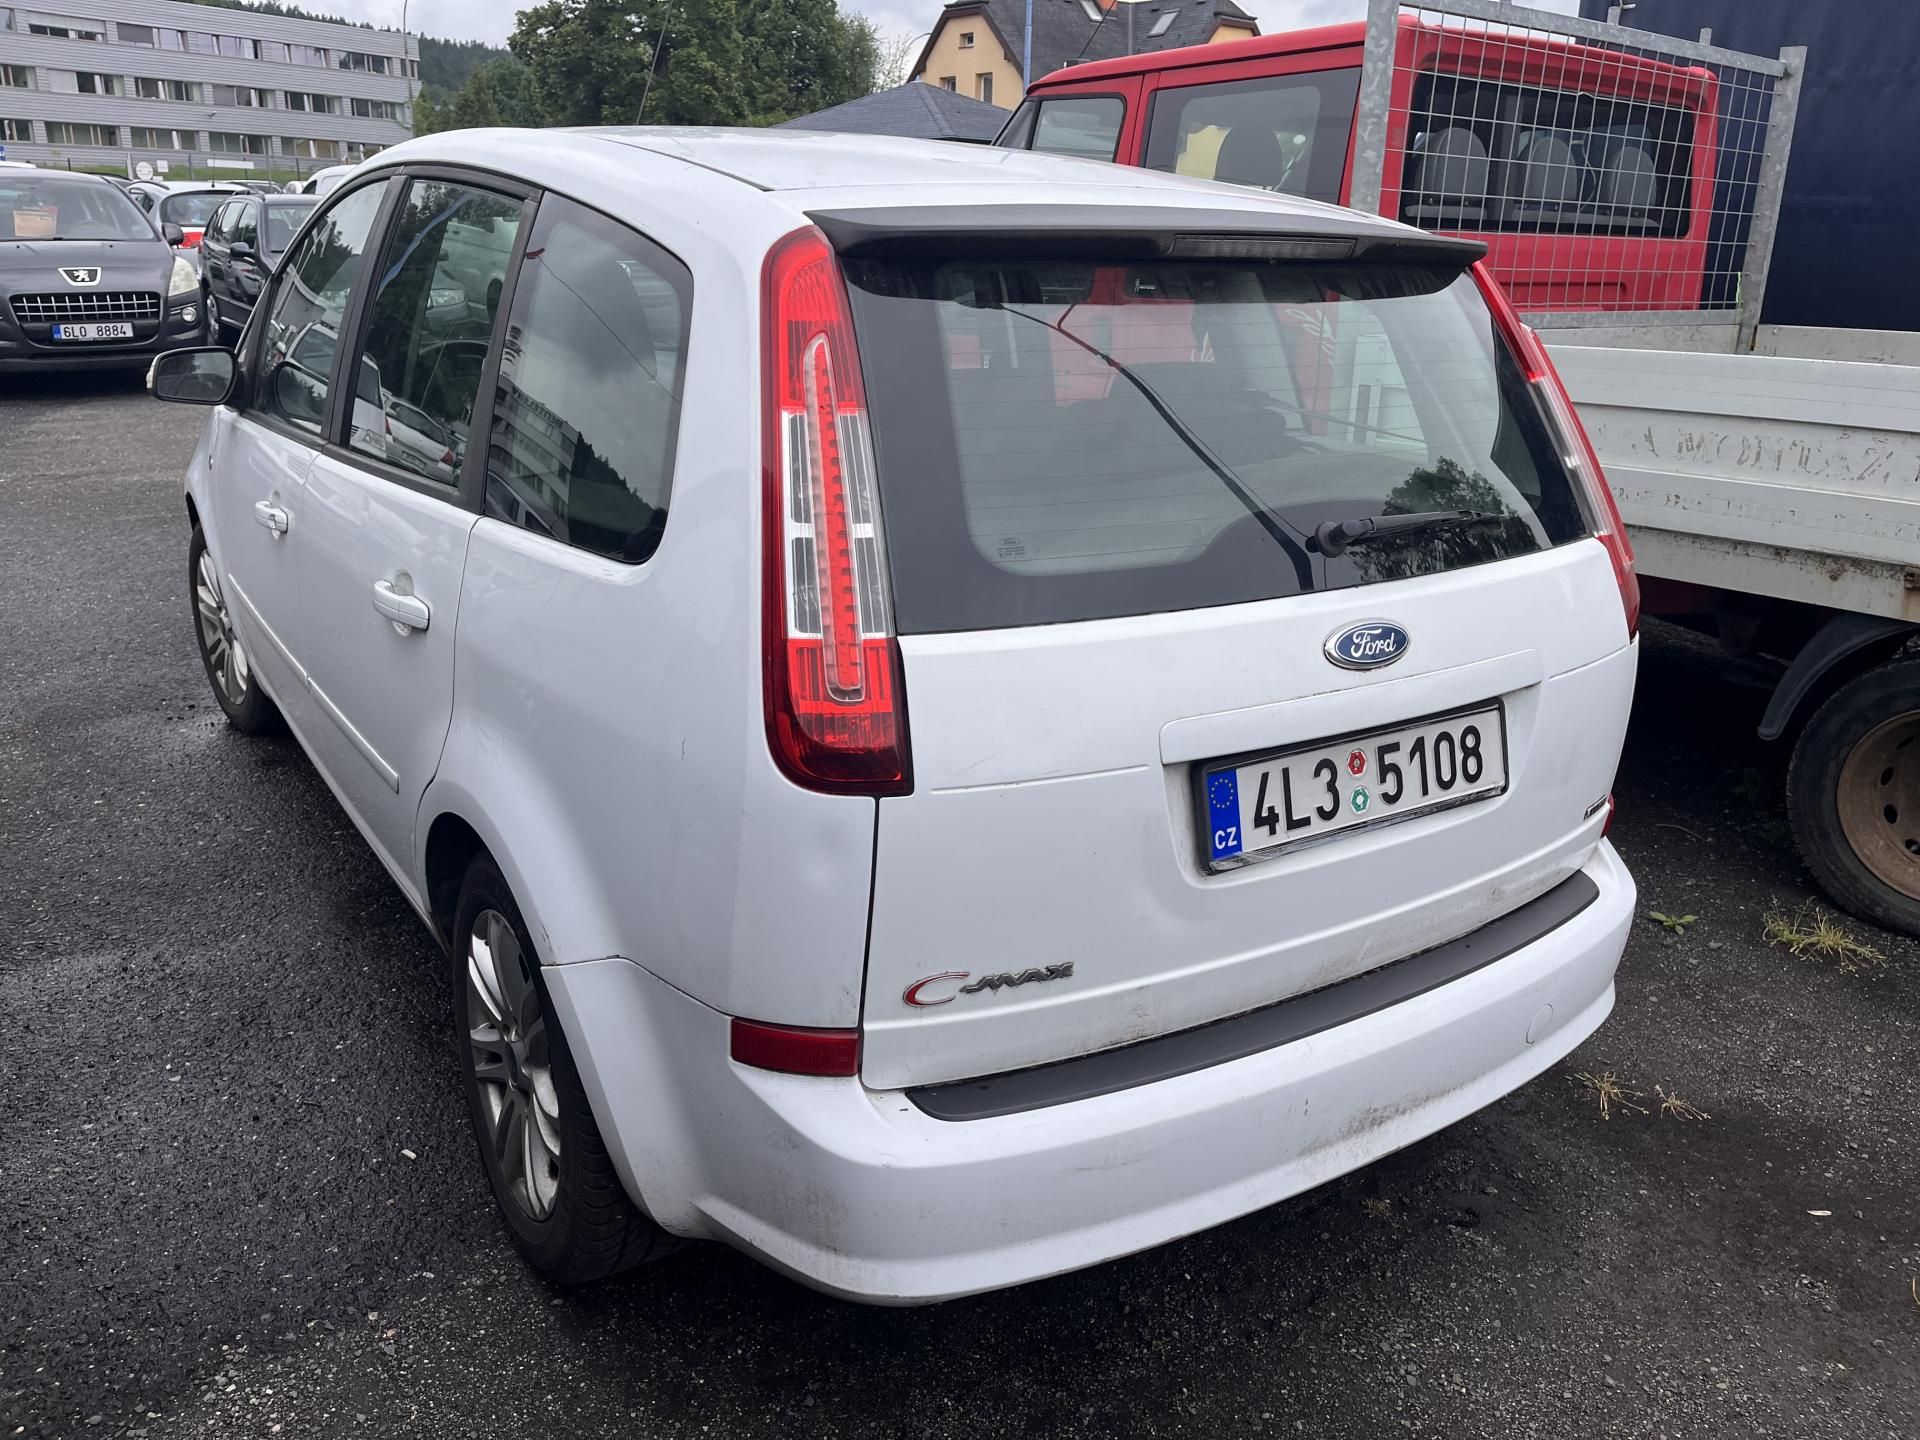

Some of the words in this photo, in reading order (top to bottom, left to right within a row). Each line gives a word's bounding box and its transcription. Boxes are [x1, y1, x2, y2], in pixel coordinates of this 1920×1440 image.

[96, 325, 126, 337] 8884
[1350, 628, 1397, 658] Ford
[1254, 758, 1341, 836] 4L3
[1376, 725, 1484, 805] 5108
[1214, 827, 1238, 850] CZ
